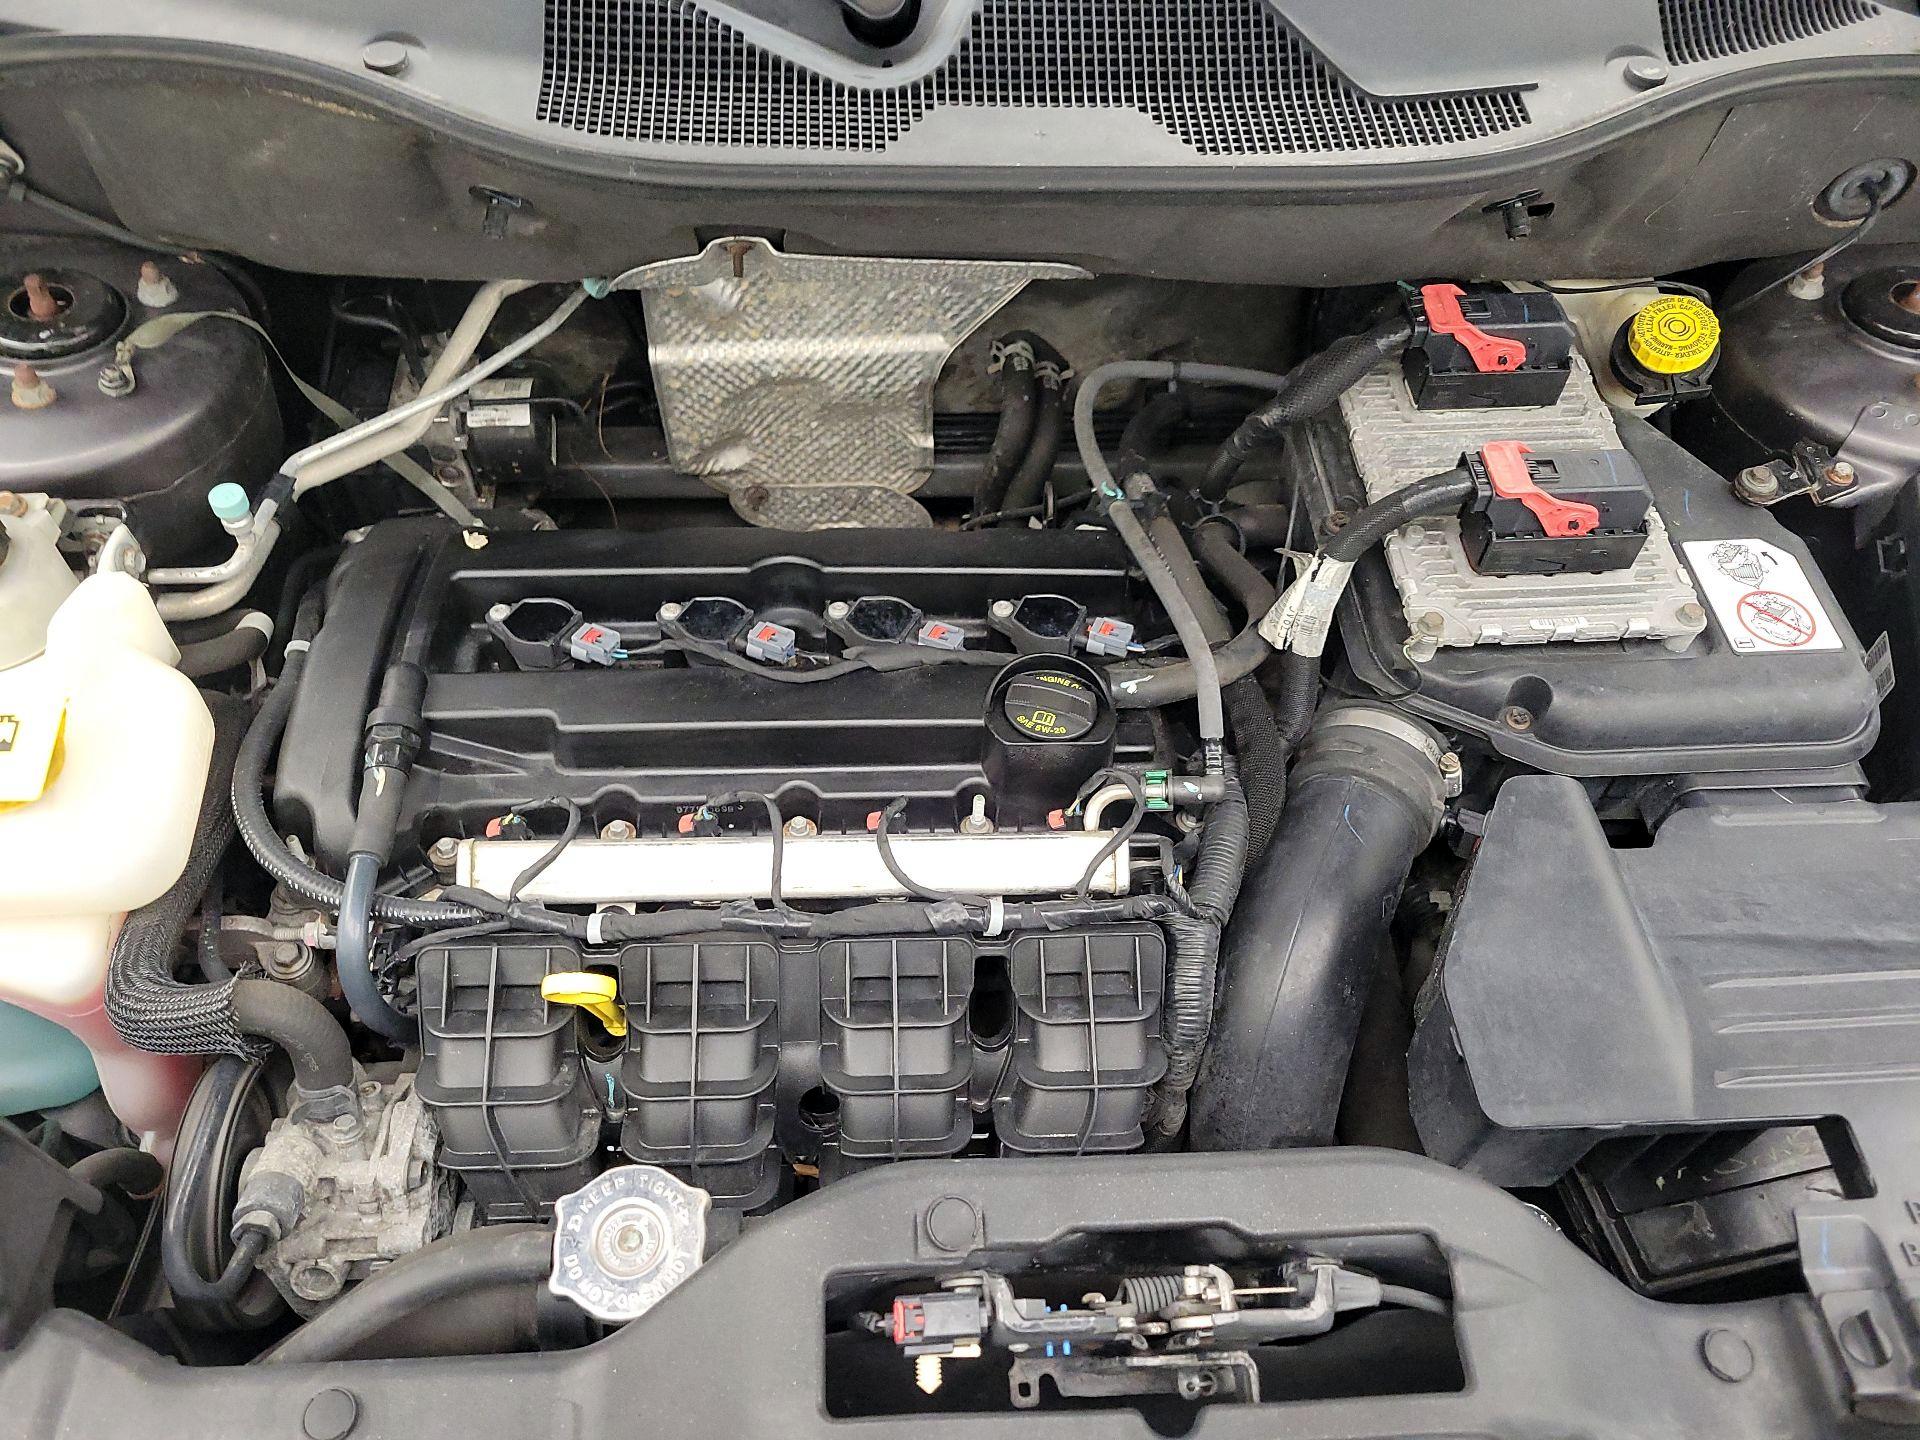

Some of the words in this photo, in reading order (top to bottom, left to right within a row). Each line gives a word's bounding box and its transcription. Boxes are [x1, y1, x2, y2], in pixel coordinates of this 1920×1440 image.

[1653, 303, 1677, 316] FILLER
[1680, 303, 1693, 311] CAP
[1646, 314, 1656, 333] CLEAN
[1693, 309, 1709, 331] BEFORE
[1678, 333, 1708, 352] REMOVING
[1016, 715, 1035, 728] SAE
[1034, 724, 1067, 734] 5W-20
[579, 1175, 627, 1214] KEEP
[639, 1174, 685, 1209] TIGHT
[563, 1254, 583, 1280] DO
[577, 1278, 614, 1306] NOT
[662, 1250, 692, 1285] HOT
